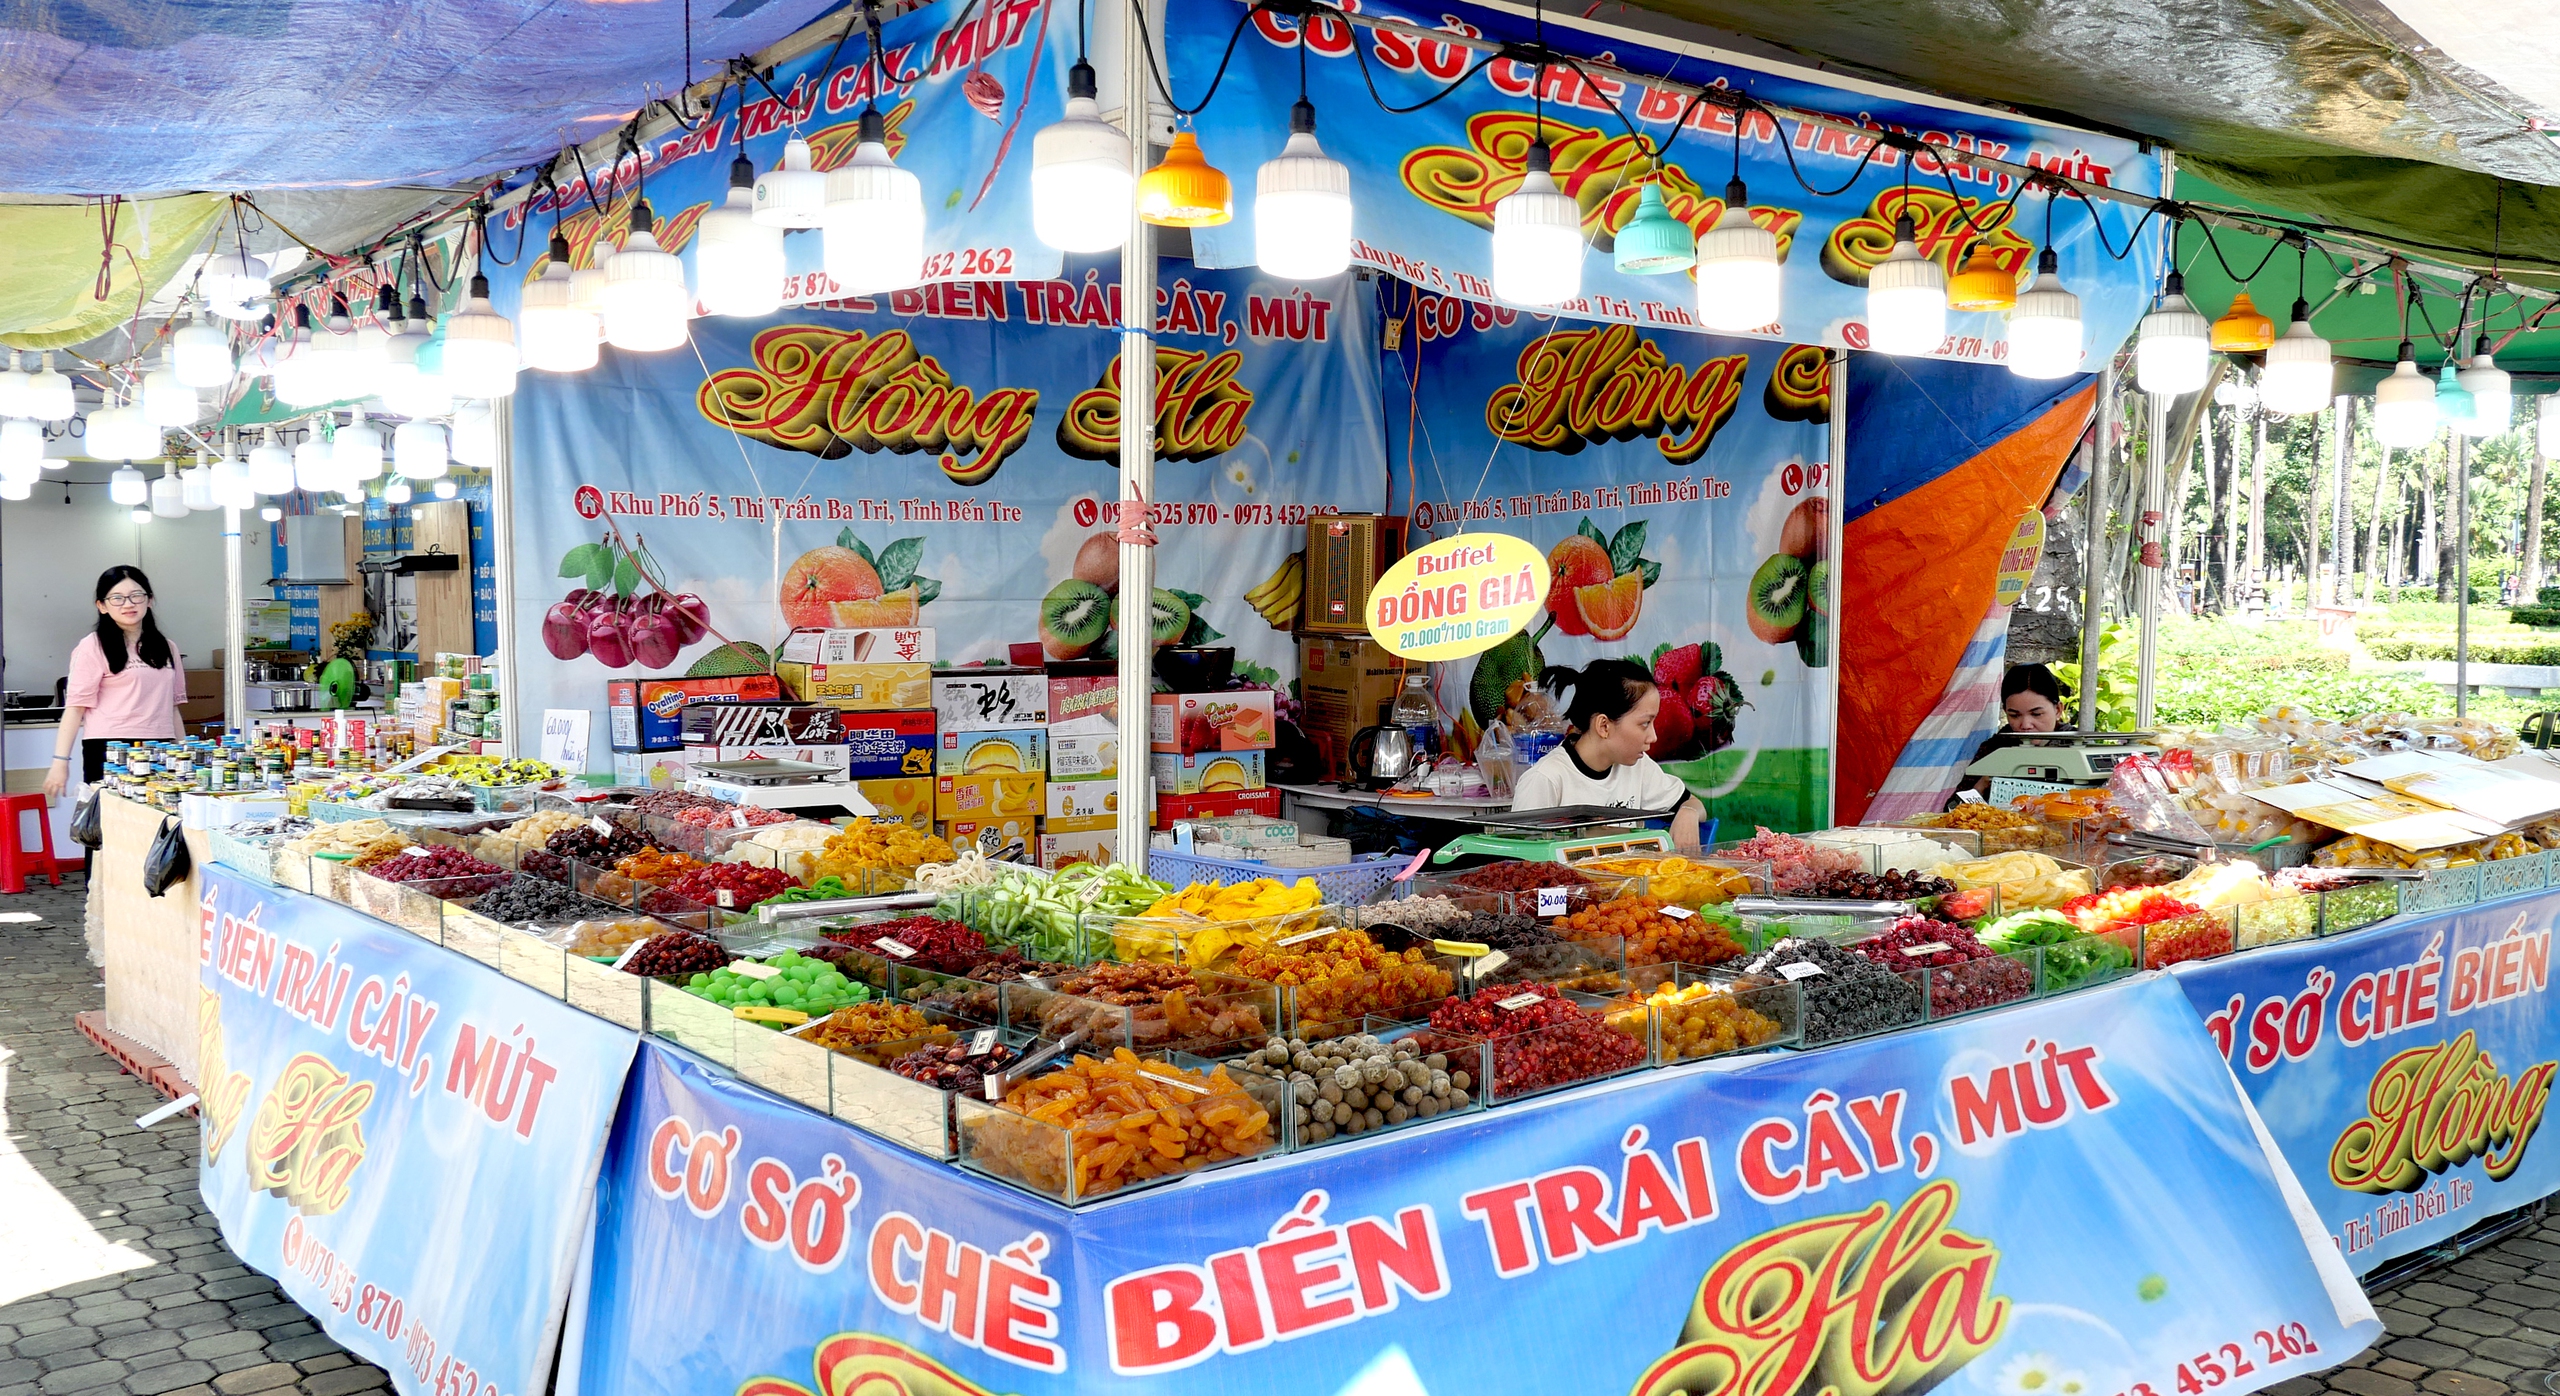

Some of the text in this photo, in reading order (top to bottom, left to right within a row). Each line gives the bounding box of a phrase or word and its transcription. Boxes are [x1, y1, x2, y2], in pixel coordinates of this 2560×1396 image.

[1373, 14, 1481, 82] SỞ
[1916, 129, 2010, 197] CÂY,
[960, 247, 1013, 275] 262
[1388, 249, 1427, 283] Phố
[1432, 267, 1453, 294] 5,
[1453, 273, 1493, 303] Thị
[1594, 295, 1638, 324] Tri,
[1644, 302, 1692, 327] Tỉnh
[1249, 287, 1331, 341] MỨT
[697, 324, 1039, 484] Hồng
[1486, 324, 1749, 462] Hồng
[1435, 478, 1731, 524] Khu Phố 5, Thị Trấn Ba Tri, Tỉnh Bến Tre
[1806, 463, 1829, 490] 097
[609, 491, 1022, 525] Khu Phố 5, Thị Trấn Ba Tri, Tỉnh Bến Tre
[1187, 503, 1217, 525] 870
[1234, 503, 1275, 525] 0973
[1277, 504, 1307, 526] 452
[1417, 542, 1496, 577] Buffet
[1377, 564, 1536, 628] ĐỒNG GIÁ
[1475, 618, 1509, 637] Gram
[1310, 655, 1323, 666] JBZ
[1366, 668, 1384, 676] Mobile
[648, 691, 685, 713] Ovaltine
[849, 729, 895, 740] 阿华田
[849, 741, 905, 754] 夹心华夫饼
[1265, 825, 1296, 838] COCO
[218, 903, 276, 996] BIẾN
[275, 943, 349, 1031] TRÁI
[351, 975, 437, 1095] CÂY,
[446, 1023, 557, 1138] MỨT
[2248, 968, 2333, 1072] SỞ
[2338, 932, 2443, 1045] CHẾ
[2450, 912, 2550, 1015] BIẾN
[253, 1053, 374, 1211] Hà
[2330, 1030, 2557, 1180] Hồng
[650, 1117, 741, 1218] CƠ
[743, 1155, 859, 1271] SỞ
[870, 1233, 1063, 1371] CHẾ
[1108, 1193, 1448, 1372] BIẾN
[1465, 1127, 1715, 1275] TRÁI
[1739, 1092, 1937, 1202] CÂY,
[1949, 1037, 2114, 1147] MỨT
[2345, 1176, 2473, 1254] Tri, Tỉnh Bến Tre
[301, 1236, 335, 1289] 0979
[329, 1262, 357, 1314] 525
[357, 1283, 405, 1341] 870
[406, 1316, 437, 1385] 0973
[1634, 1180, 2010, 1396] Hà
[2177, 1322, 2318, 1396] 452 262
